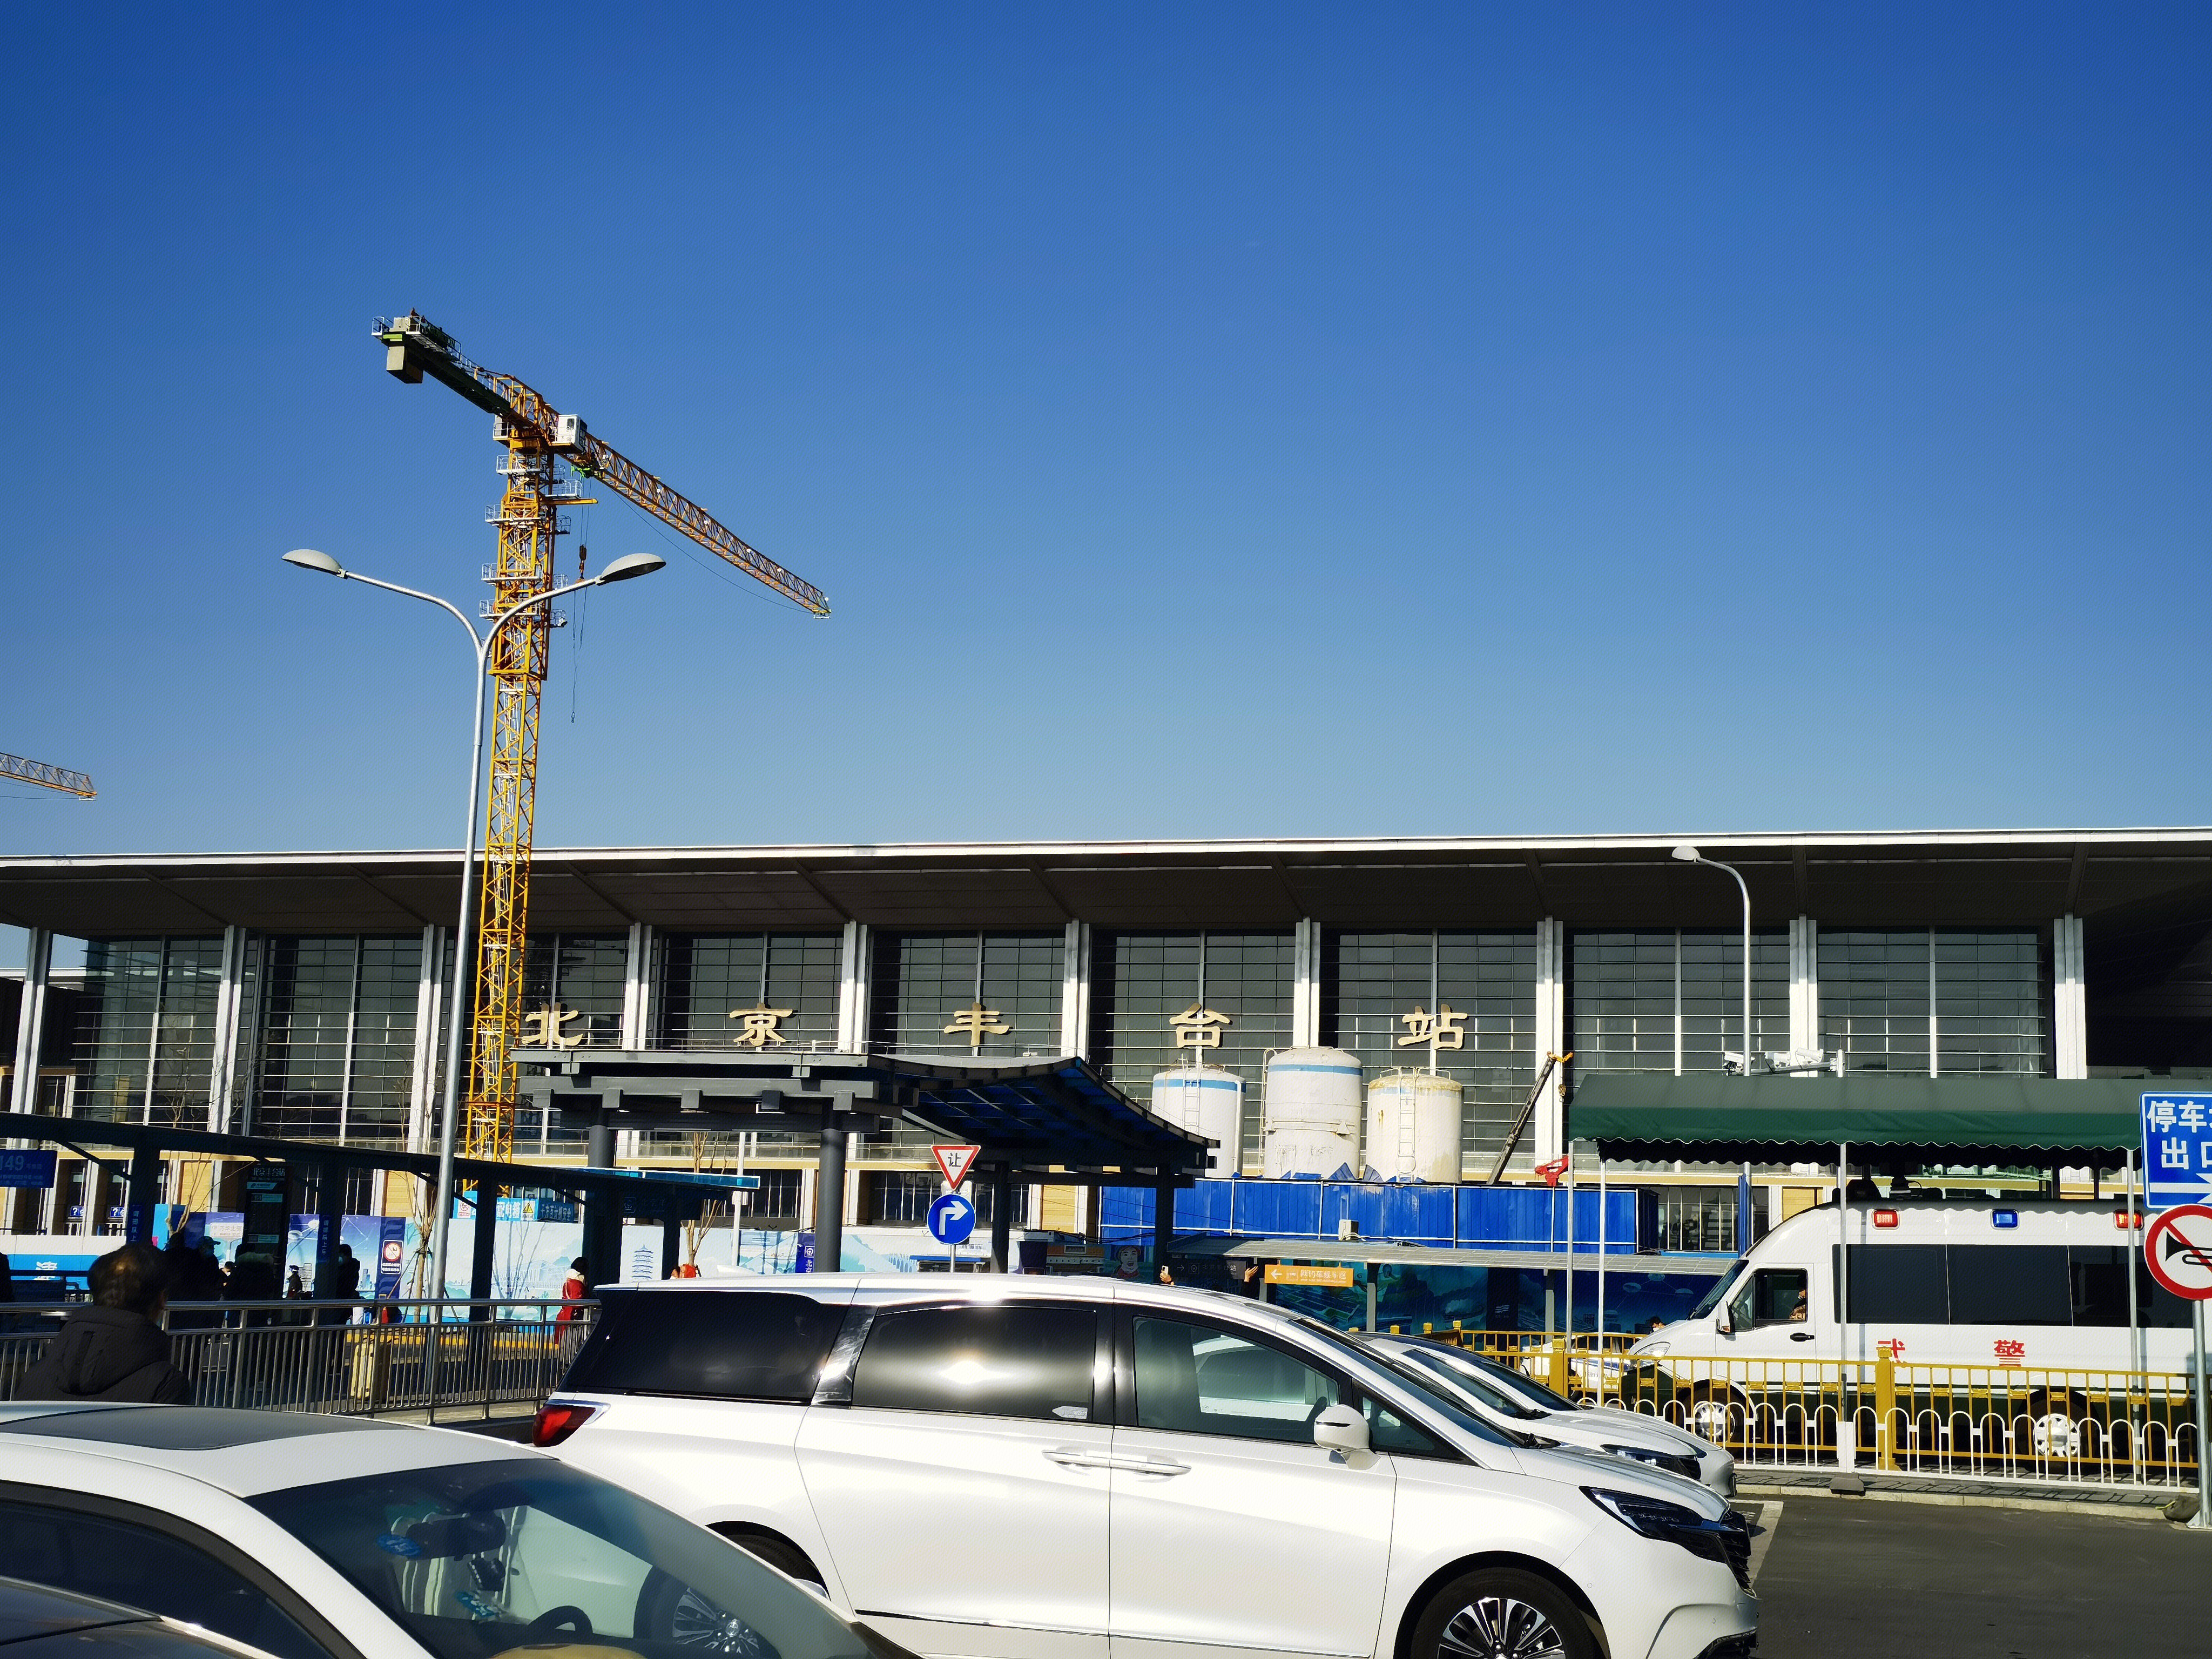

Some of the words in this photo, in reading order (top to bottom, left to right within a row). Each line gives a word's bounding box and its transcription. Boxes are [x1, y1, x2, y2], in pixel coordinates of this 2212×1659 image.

[521, 1002, 1468, 1049] 北京丰台站
[2147, 1100, 2212, 1133] 停车
[948, 1152, 961, 1167] 让
